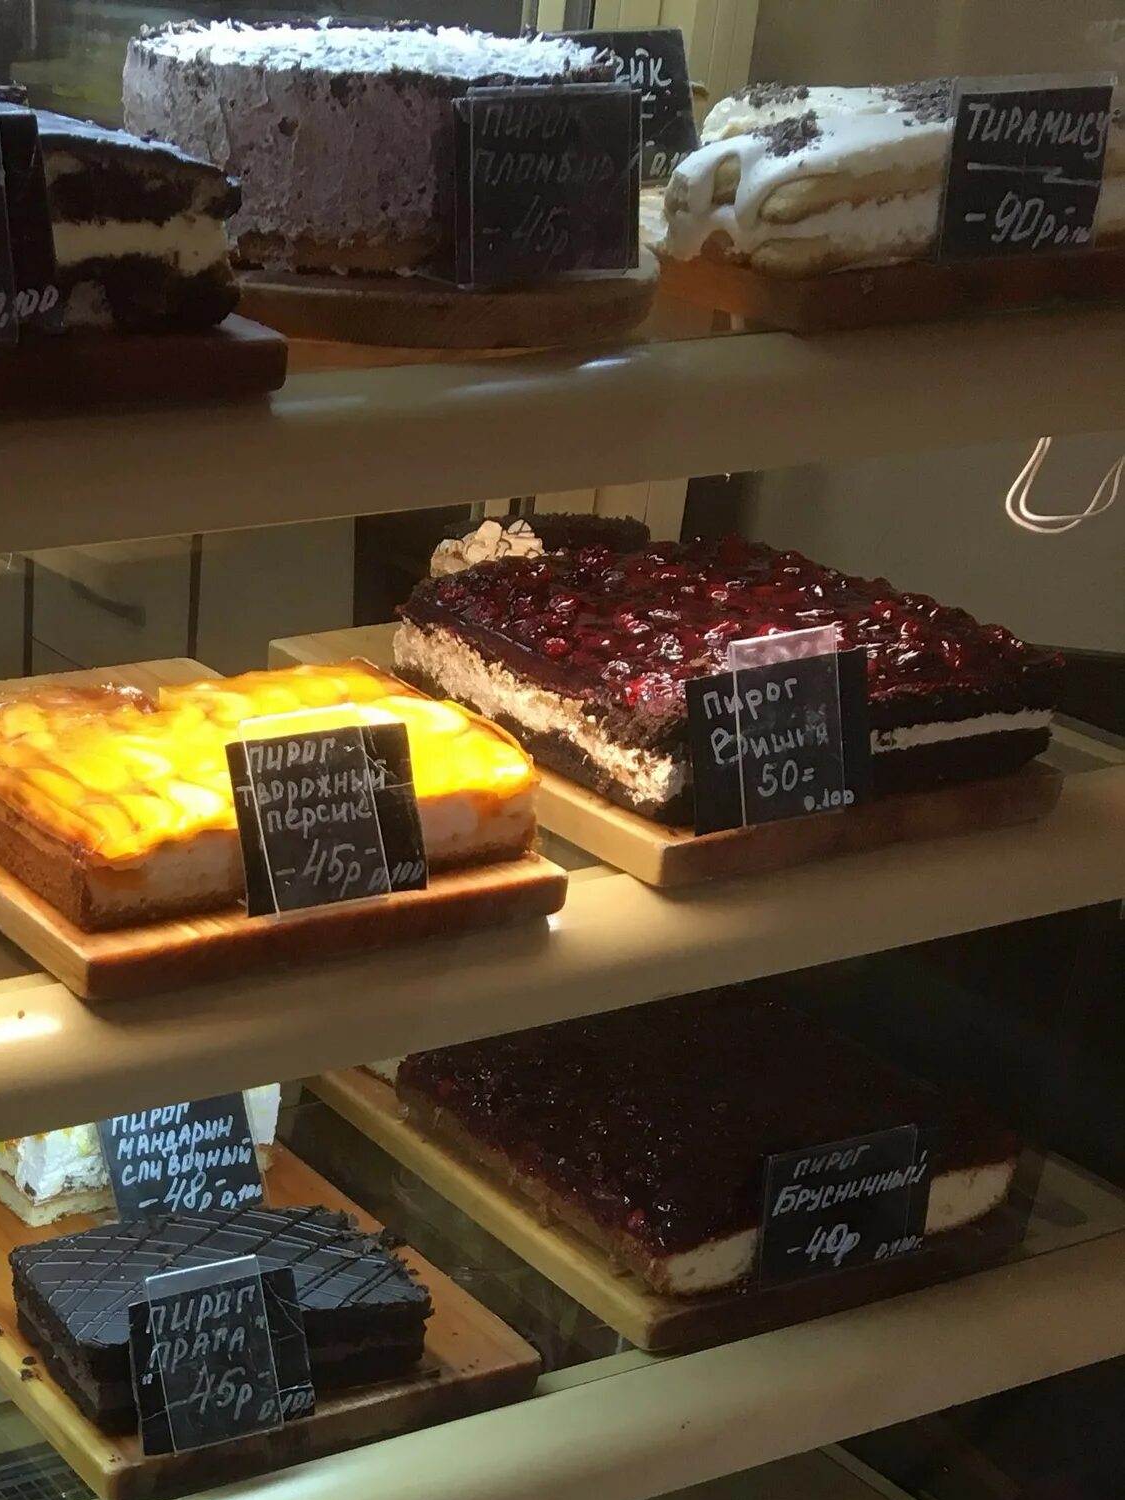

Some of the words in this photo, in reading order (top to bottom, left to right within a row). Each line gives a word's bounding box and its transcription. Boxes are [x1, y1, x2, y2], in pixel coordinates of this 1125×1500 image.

[968, 102, 1114, 159] ТИРАМИСУ
[111, 1101, 191, 1137] ПИРОГ
[145, 1284, 256, 1335] ПИРОГ
